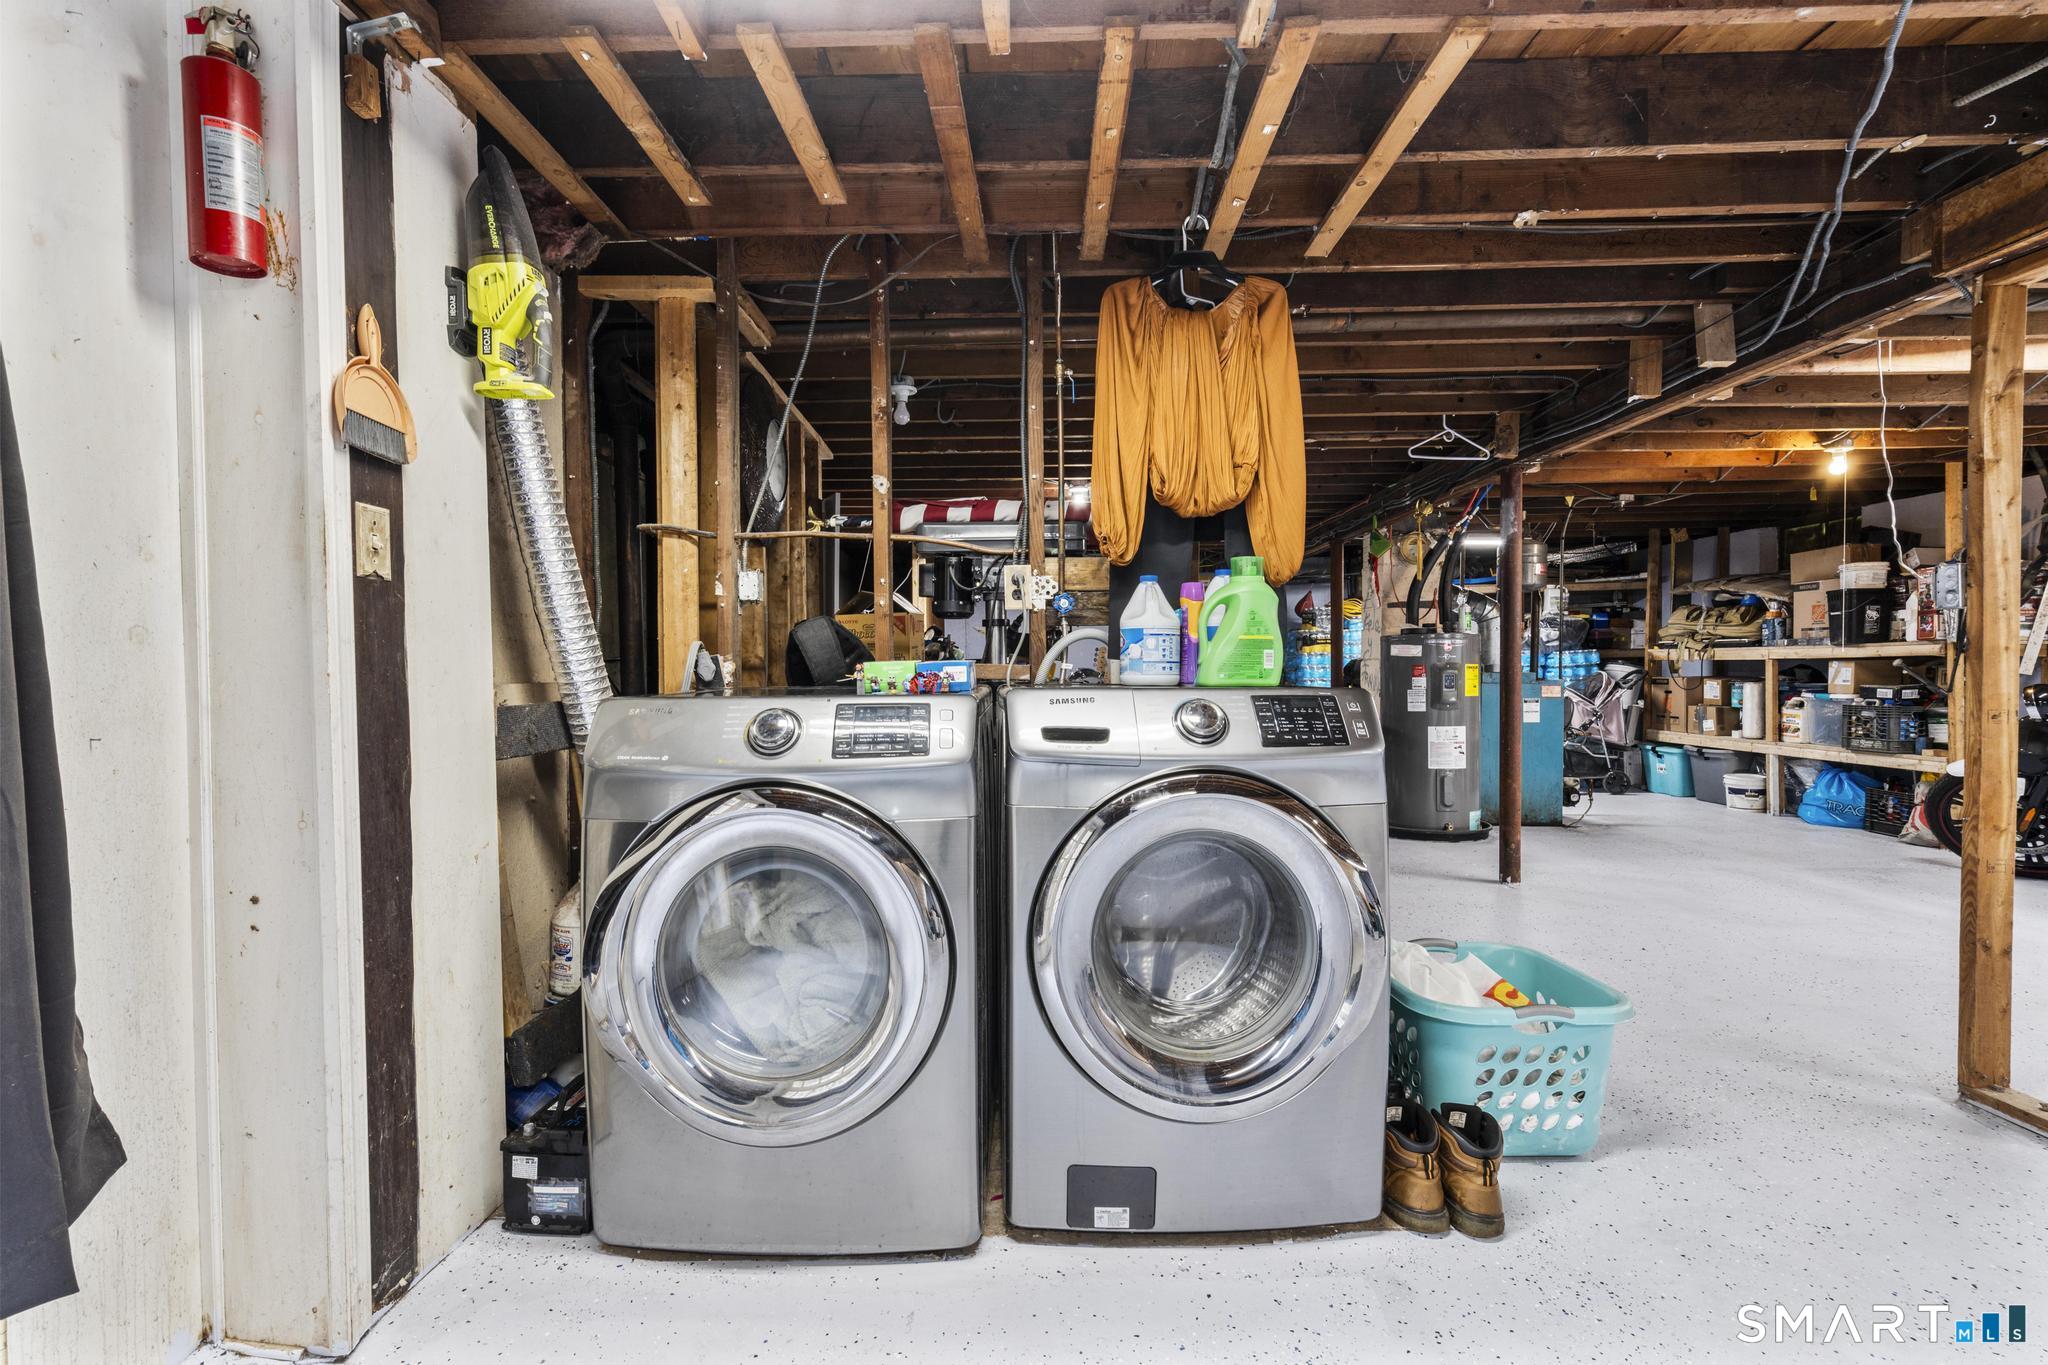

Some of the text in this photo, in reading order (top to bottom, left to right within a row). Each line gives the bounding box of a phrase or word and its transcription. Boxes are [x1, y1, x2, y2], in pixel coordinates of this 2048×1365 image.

[485, 205, 500, 249] EVERCHARGE
[483, 328, 491, 354] RYOBI
[628, 704, 673, 716] SAUNG
[1049, 696, 1096, 706] SAMSUNG
